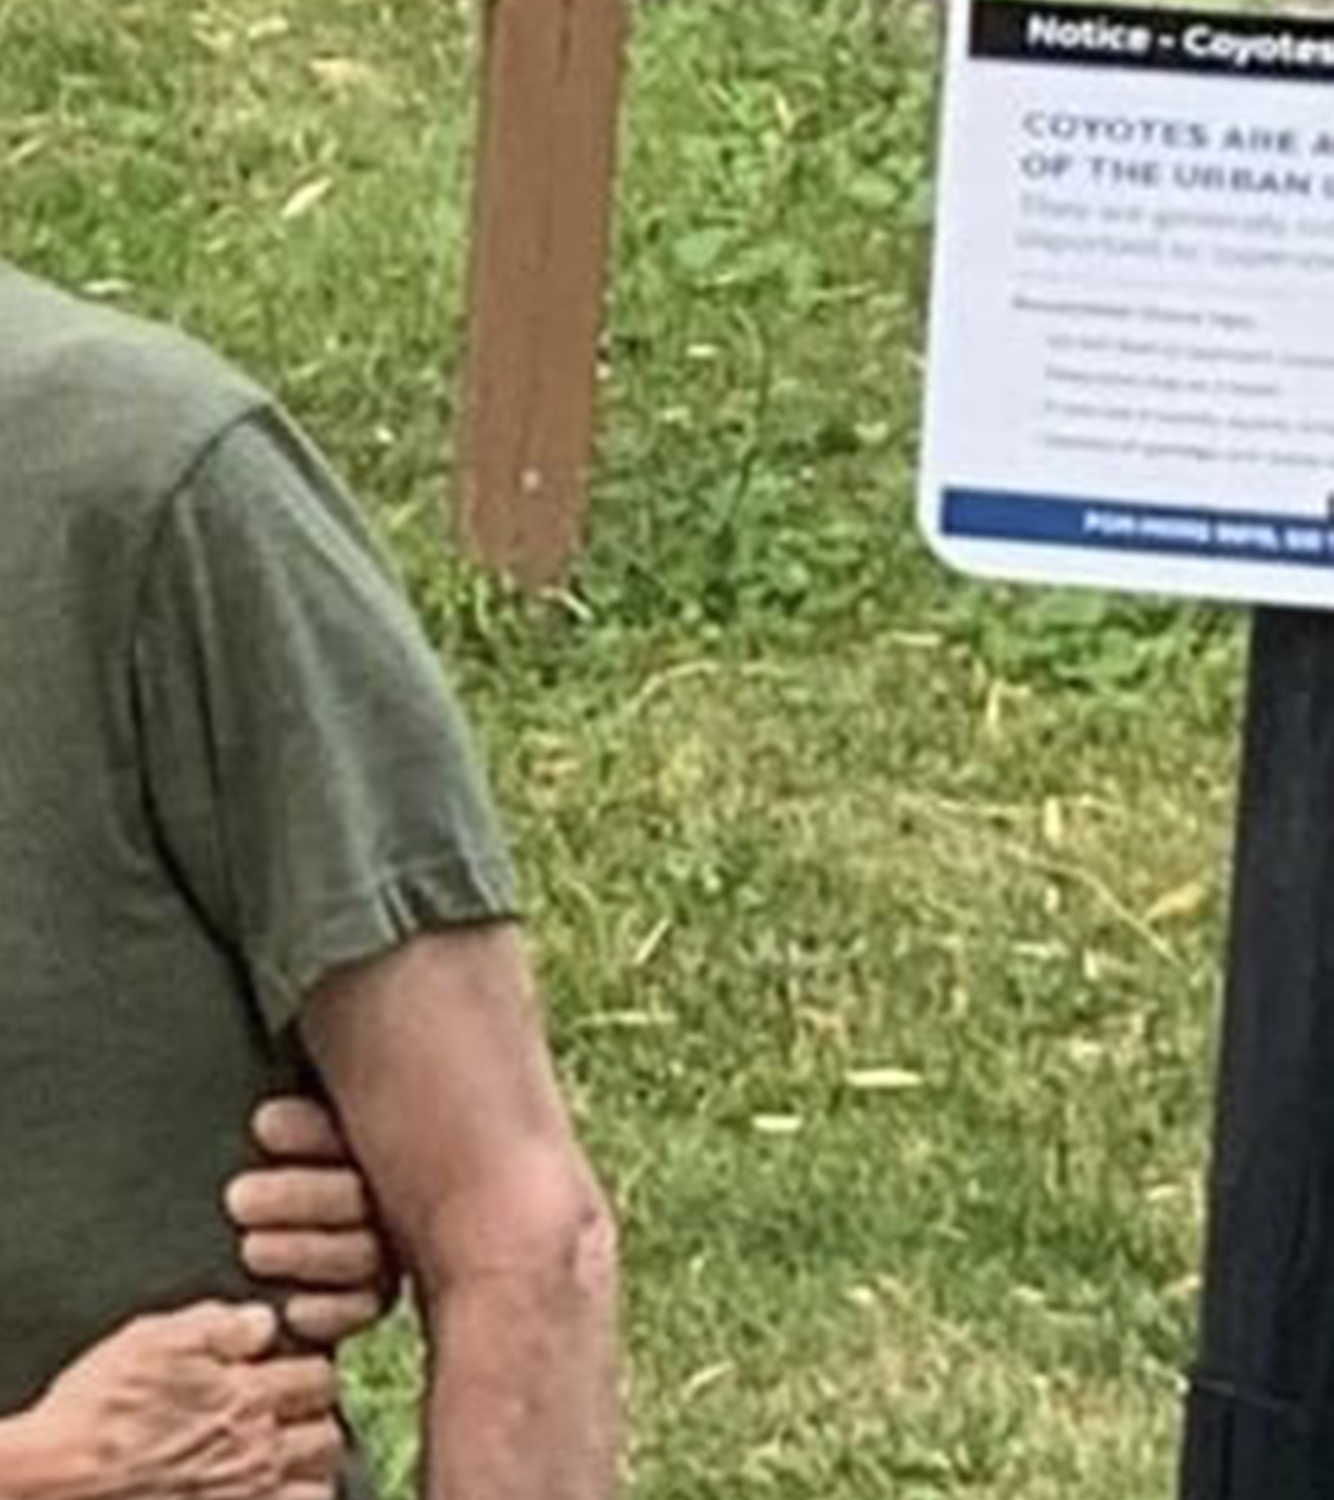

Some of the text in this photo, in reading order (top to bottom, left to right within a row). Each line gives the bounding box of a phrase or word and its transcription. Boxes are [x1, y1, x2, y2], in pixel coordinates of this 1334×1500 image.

[1027, 14, 1150, 54] Notice
[1021, 110, 1208, 149] COYOTES
[1222, 124, 1296, 151] ARE
[1020, 151, 1072, 179] OF
[1089, 156, 1160, 187] THE
[1173, 164, 1313, 196] URBAN
